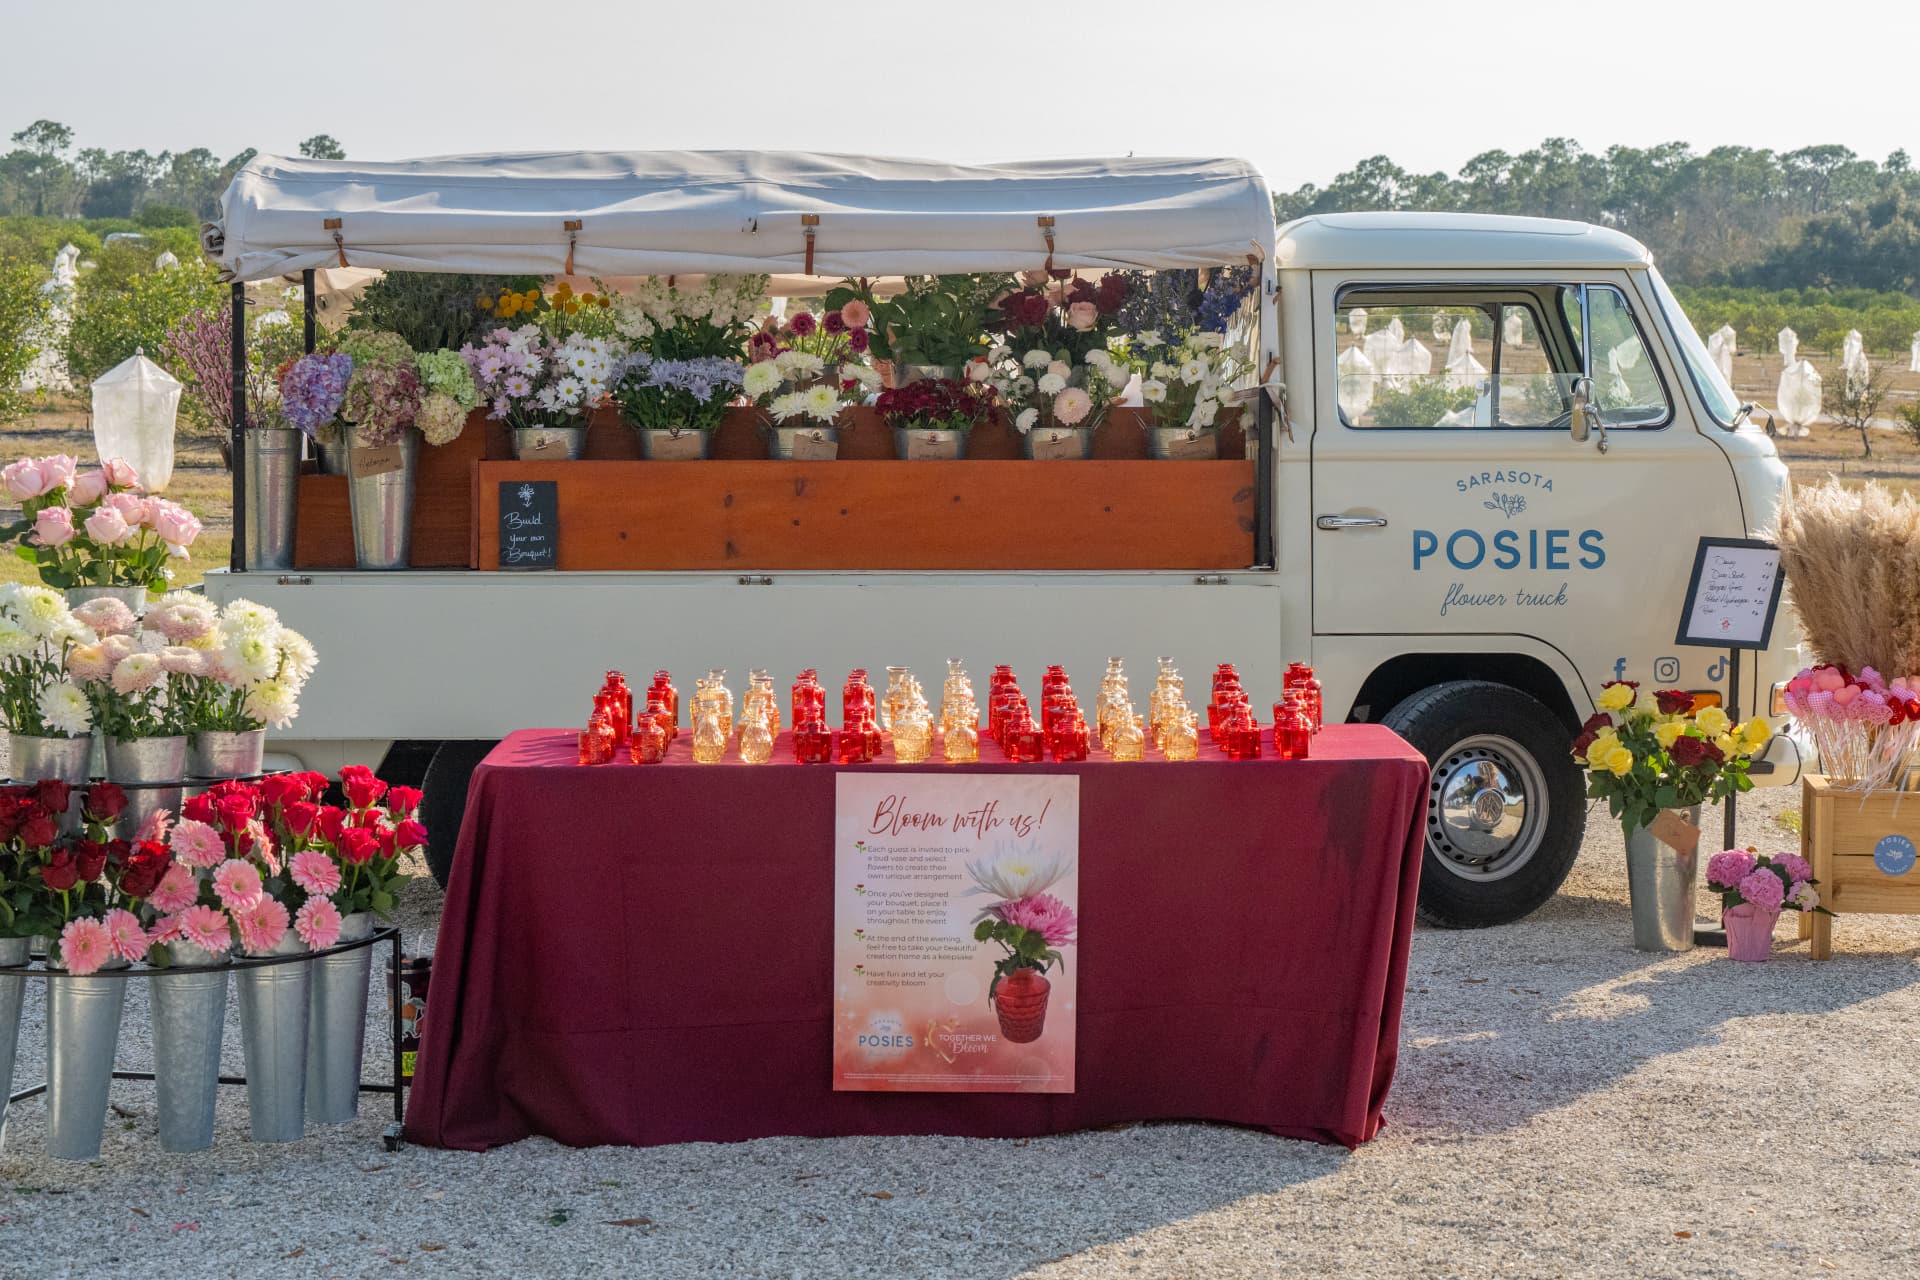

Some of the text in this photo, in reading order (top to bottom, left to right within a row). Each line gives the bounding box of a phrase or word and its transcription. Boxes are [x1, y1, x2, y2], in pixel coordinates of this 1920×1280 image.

[1456, 470, 1553, 493] SARASOTA
[504, 511, 544, 530] Build
[508, 533, 527, 549] your
[1412, 529, 1606, 570] POSIES
[1440, 582, 1568, 617] flower truck
[868, 794, 1051, 839] Bloom with us!
[888, 847, 908, 855] guest
[954, 846, 971, 855] pick
[885, 873, 911, 881] unique
[867, 890, 948, 900] Once you've designed
[920, 899, 940, 907] place
[897, 908, 915, 916] table
[926, 908, 946, 917] enjoy
[866, 917, 910, 926] throughout
[866, 979, 900, 987] creativity
[858, 1035, 914, 1048] POSIES
[939, 1034, 997, 1042] TOGETHER WE
